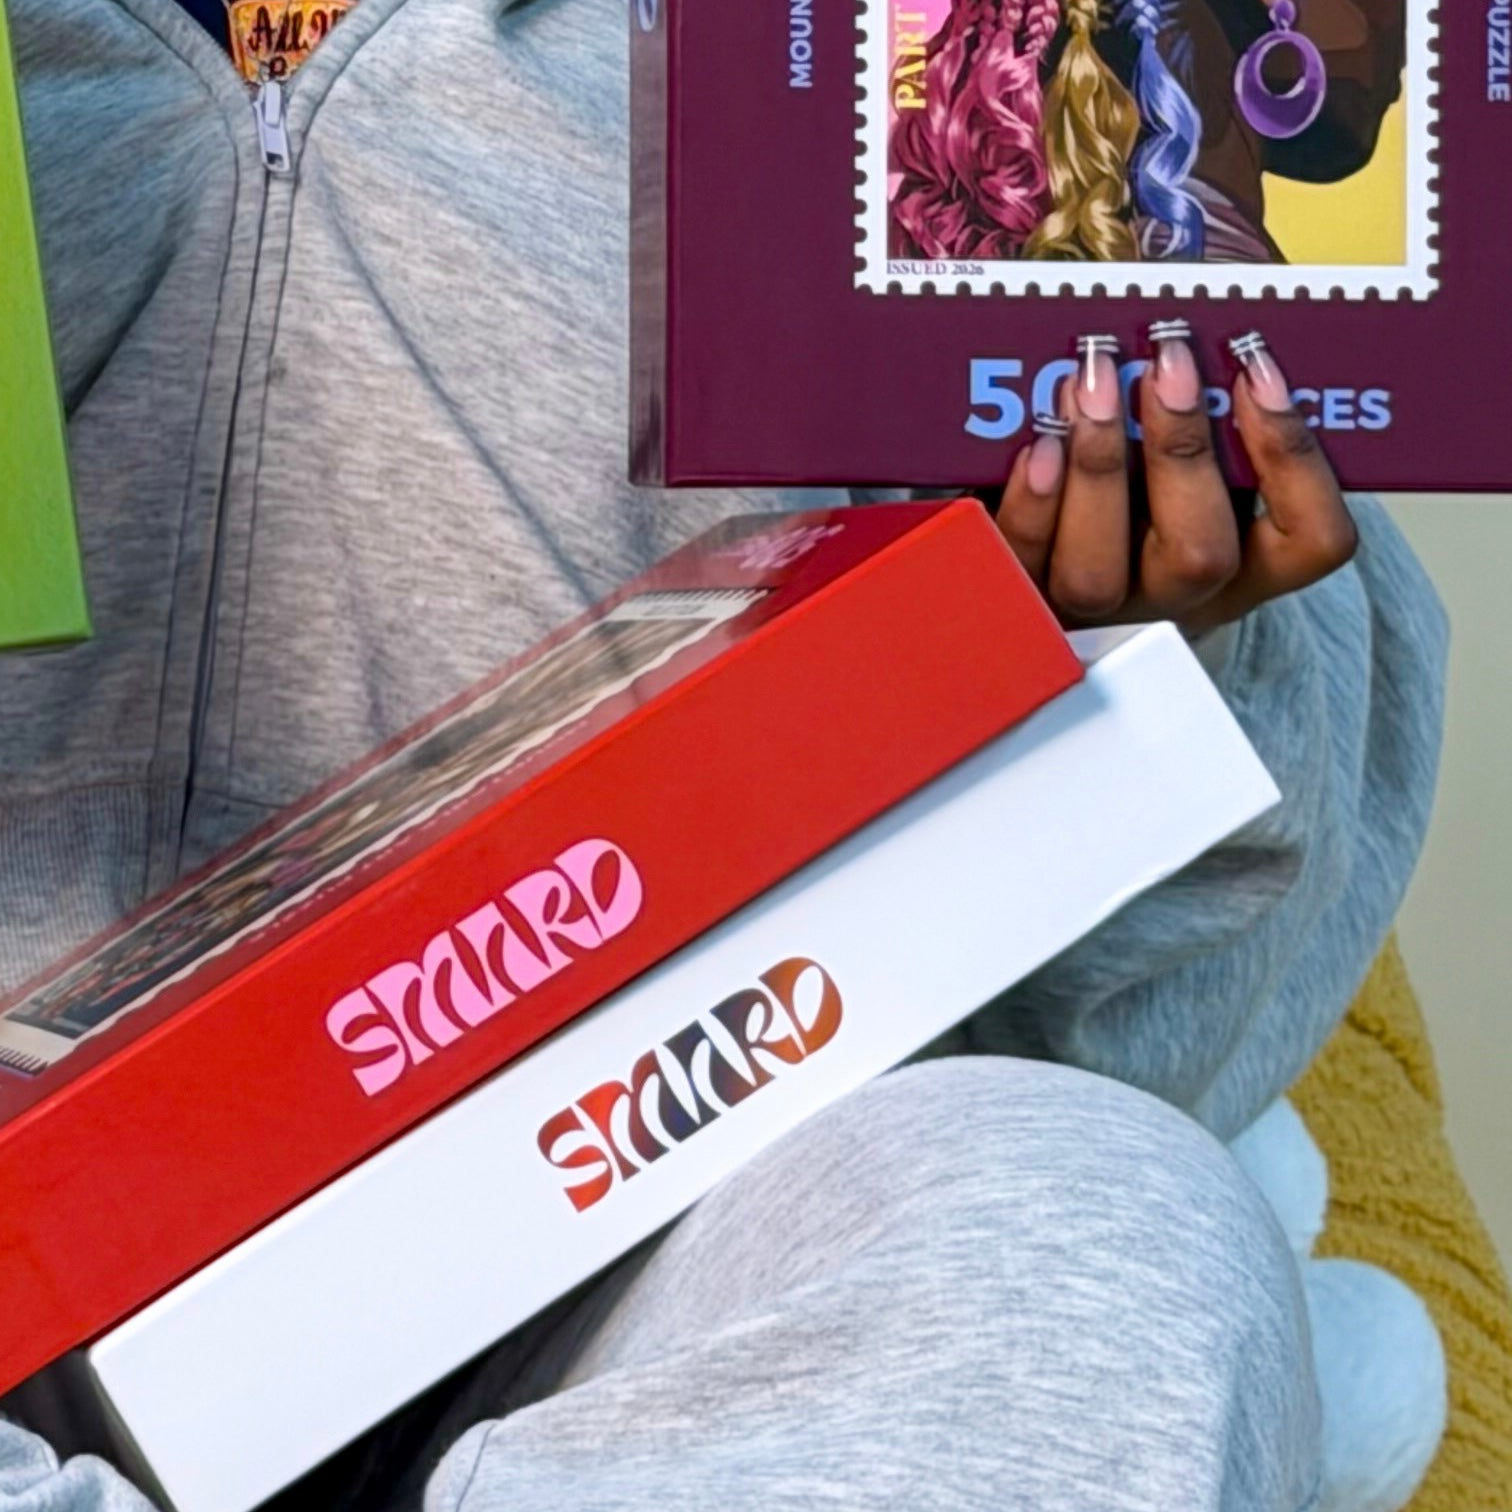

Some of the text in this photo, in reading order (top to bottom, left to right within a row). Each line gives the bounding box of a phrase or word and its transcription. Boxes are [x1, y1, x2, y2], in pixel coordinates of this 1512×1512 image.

[894, 3, 927, 109] PART
[886, 262, 947, 275] ISSUED
[324, 838, 643, 1097] SMARD
[536, 957, 843, 1213] SMARD
